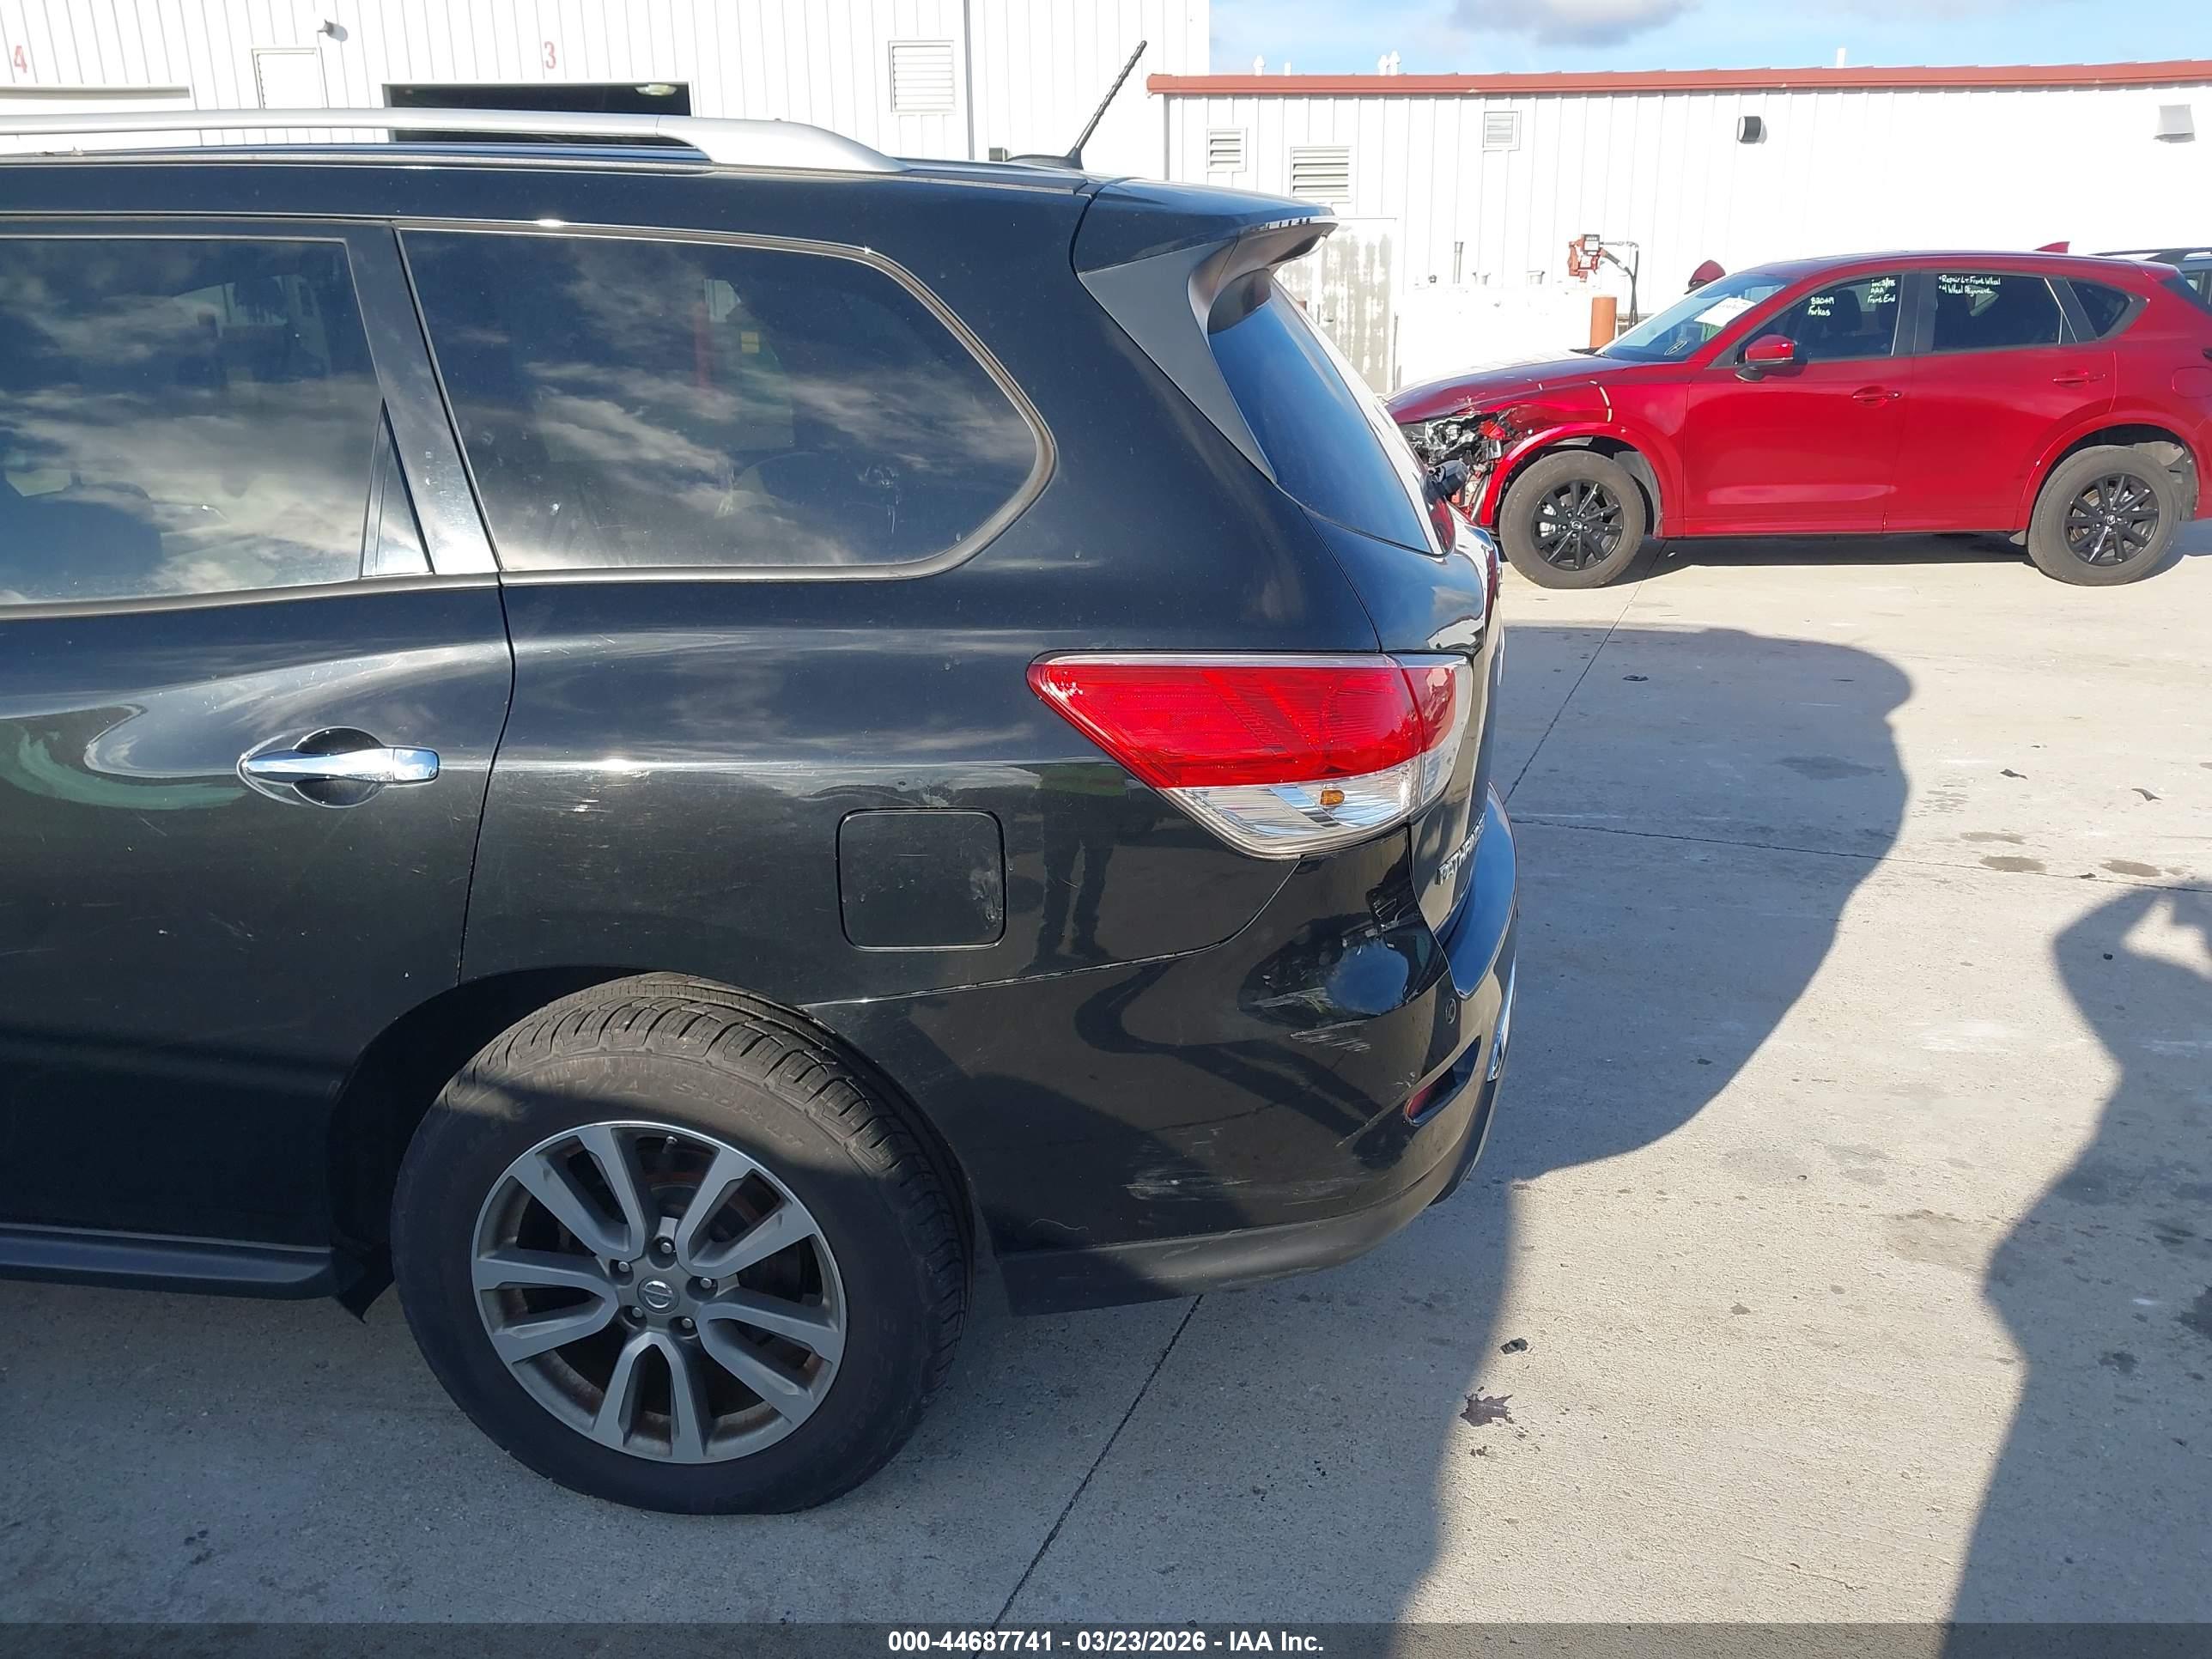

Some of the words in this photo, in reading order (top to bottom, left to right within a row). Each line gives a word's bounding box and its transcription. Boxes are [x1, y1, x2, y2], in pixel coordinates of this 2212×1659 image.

[15, 46, 27, 73] 4
[544, 41, 556, 69] 3
[1942, 275, 1960, 284] Repair
[1970, 276, 1984, 285] Front
[1984, 276, 2001, 286] Wheel
[1948, 283, 1964, 294] Wheel
[1867, 295, 1882, 303] Front
[1883, 294, 1896, 302] End
